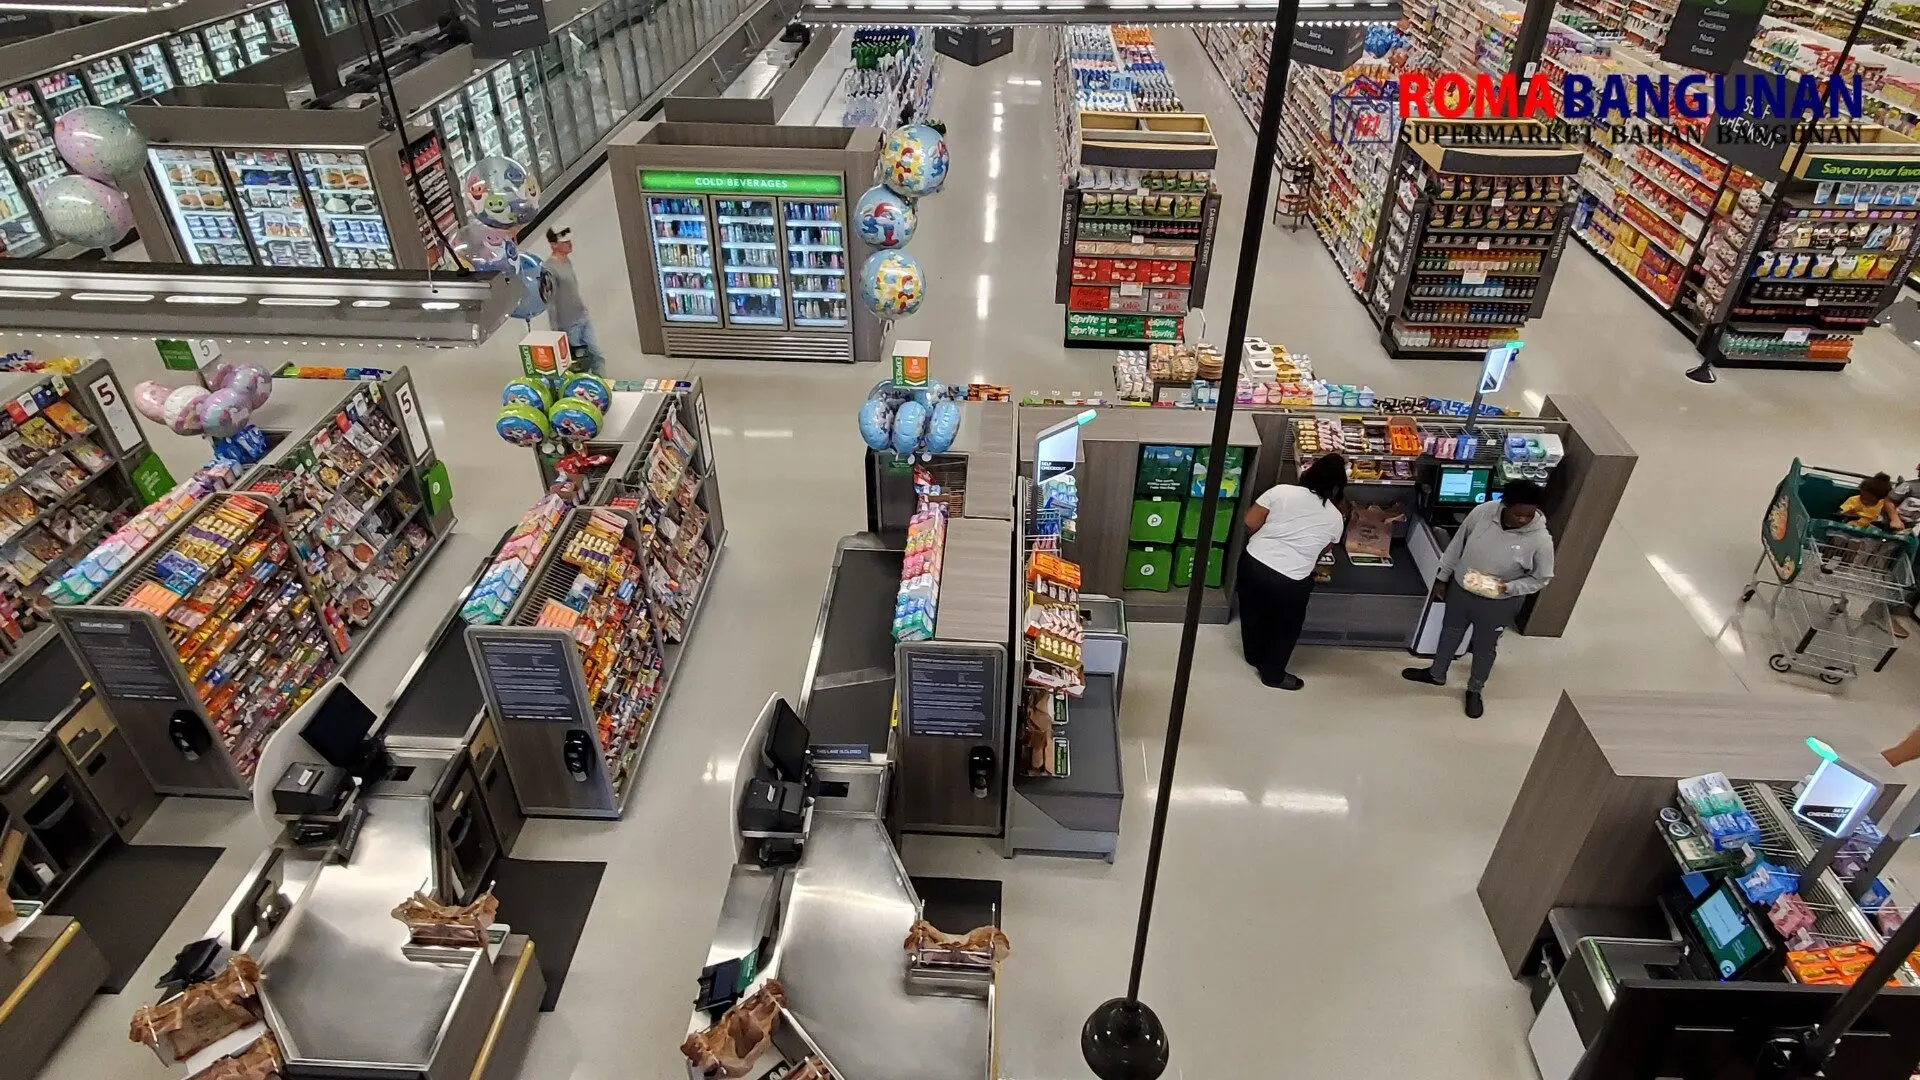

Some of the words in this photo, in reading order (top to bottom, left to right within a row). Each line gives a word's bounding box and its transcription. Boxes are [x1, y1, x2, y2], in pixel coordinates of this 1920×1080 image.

[1698, 19, 1727, 32] Crackers
[1699, 33, 1716, 43] Nuts
[1821, 163, 1850, 174] Save
[1852, 167, 1867, 175] on
[1867, 168, 1896, 179] your
[695, 177, 724, 186] COLD
[726, 178, 788, 188] BEVERAGES
[1063, 203, 1073, 245] GUARANTEED
[1070, 314, 1100, 326] Sprite
[1070, 325, 1099, 337] Sprite
[895, 357, 903, 385] EXPRESS
[97, 382, 116, 406] 5
[400, 390, 412, 414] 5
